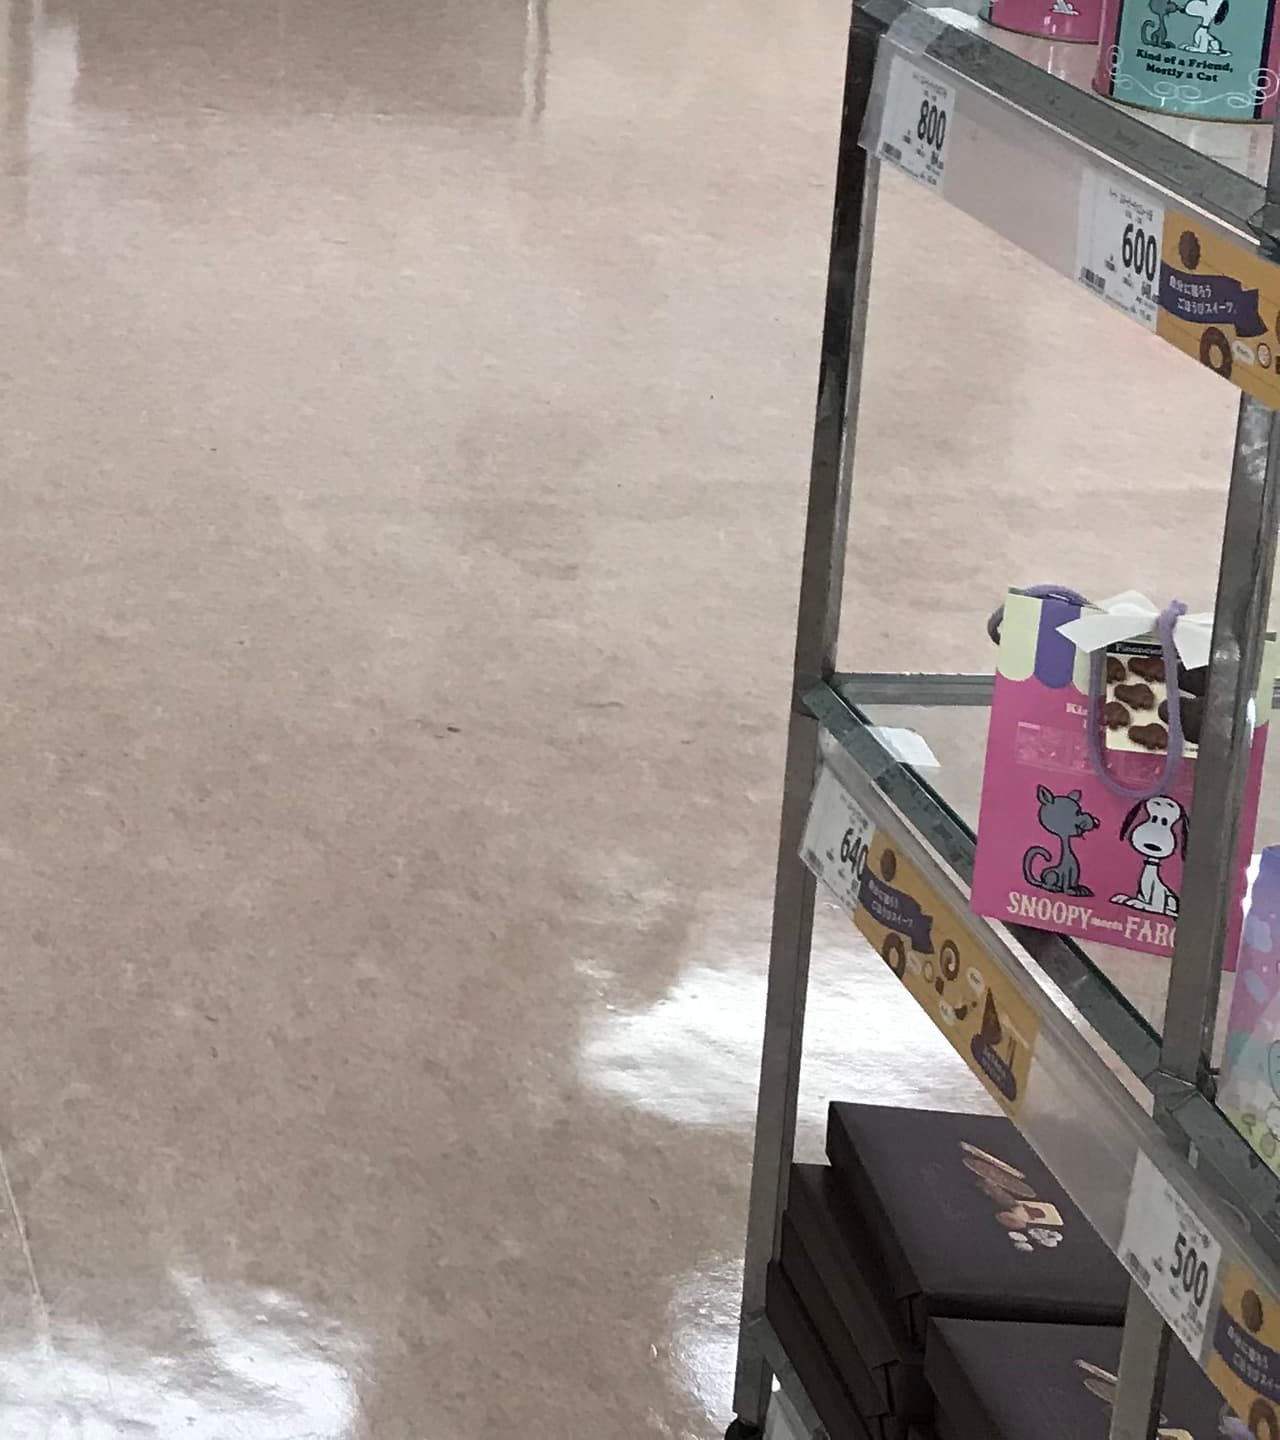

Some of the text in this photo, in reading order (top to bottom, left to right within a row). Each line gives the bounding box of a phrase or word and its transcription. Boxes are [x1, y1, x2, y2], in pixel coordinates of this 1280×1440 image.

[1136, 49, 1161, 62] Kind
[1164, 56, 1176, 65] of
[1188, 59, 1233, 73] Friend,
[1146, 63, 1218, 82] Mostly a Cat
[917, 99, 946, 151] 800
[1122, 223, 1157, 281] 600
[841, 828, 868, 880] 640
[1006, 891, 1093, 931] SNOOPY
[1124, 916, 1175, 948] FAR
[1170, 1232, 1208, 1307] 500
